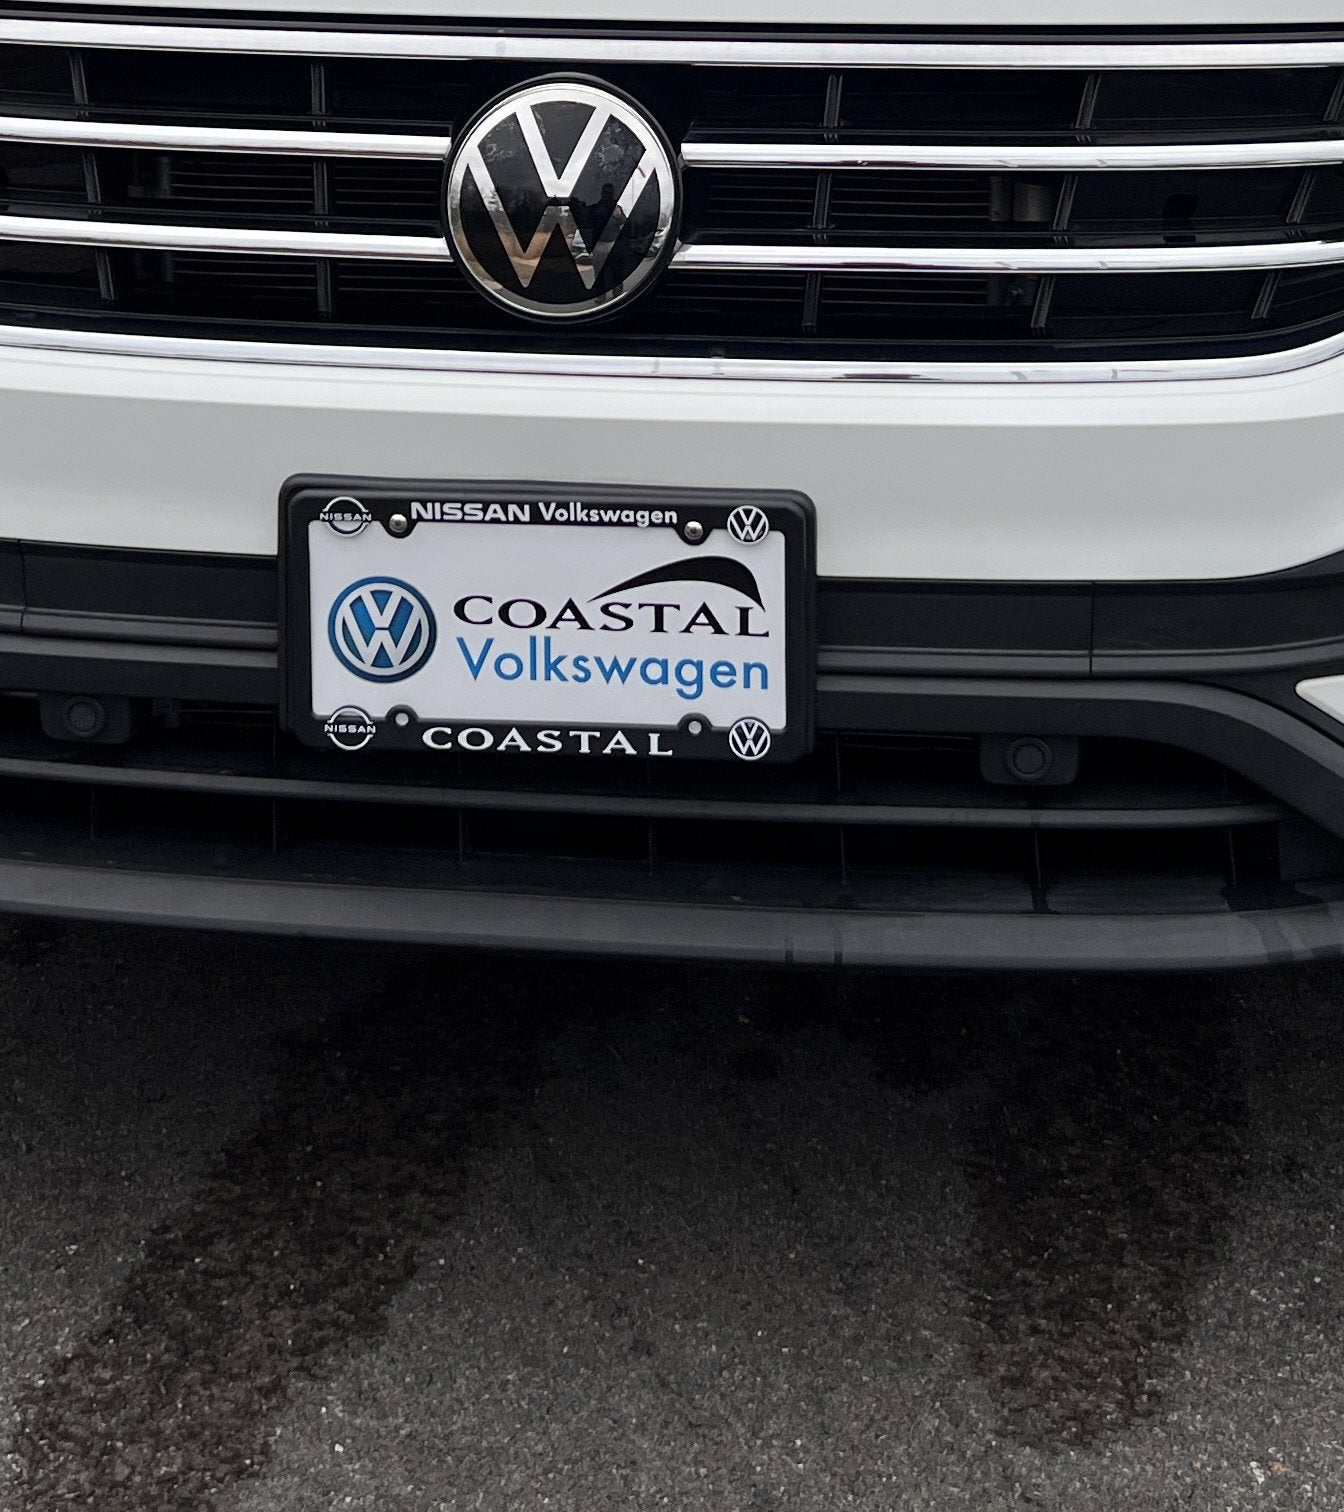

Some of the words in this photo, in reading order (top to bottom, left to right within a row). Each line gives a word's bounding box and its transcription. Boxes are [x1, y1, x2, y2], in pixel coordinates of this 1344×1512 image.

[453, 87, 669, 302] VW
[319, 512, 372, 522] NISSAN
[411, 501, 530, 523] NISSAN
[538, 501, 678, 528] Volkswagen
[728, 506, 768, 544] VW
[334, 581, 431, 677] VW
[453, 594, 770, 638] COASTAL
[457, 635, 769, 700] Volkswagen
[324, 724, 376, 734] NISSAN
[422, 726, 673, 757] COASTAL
[729, 720, 769, 759] VW
